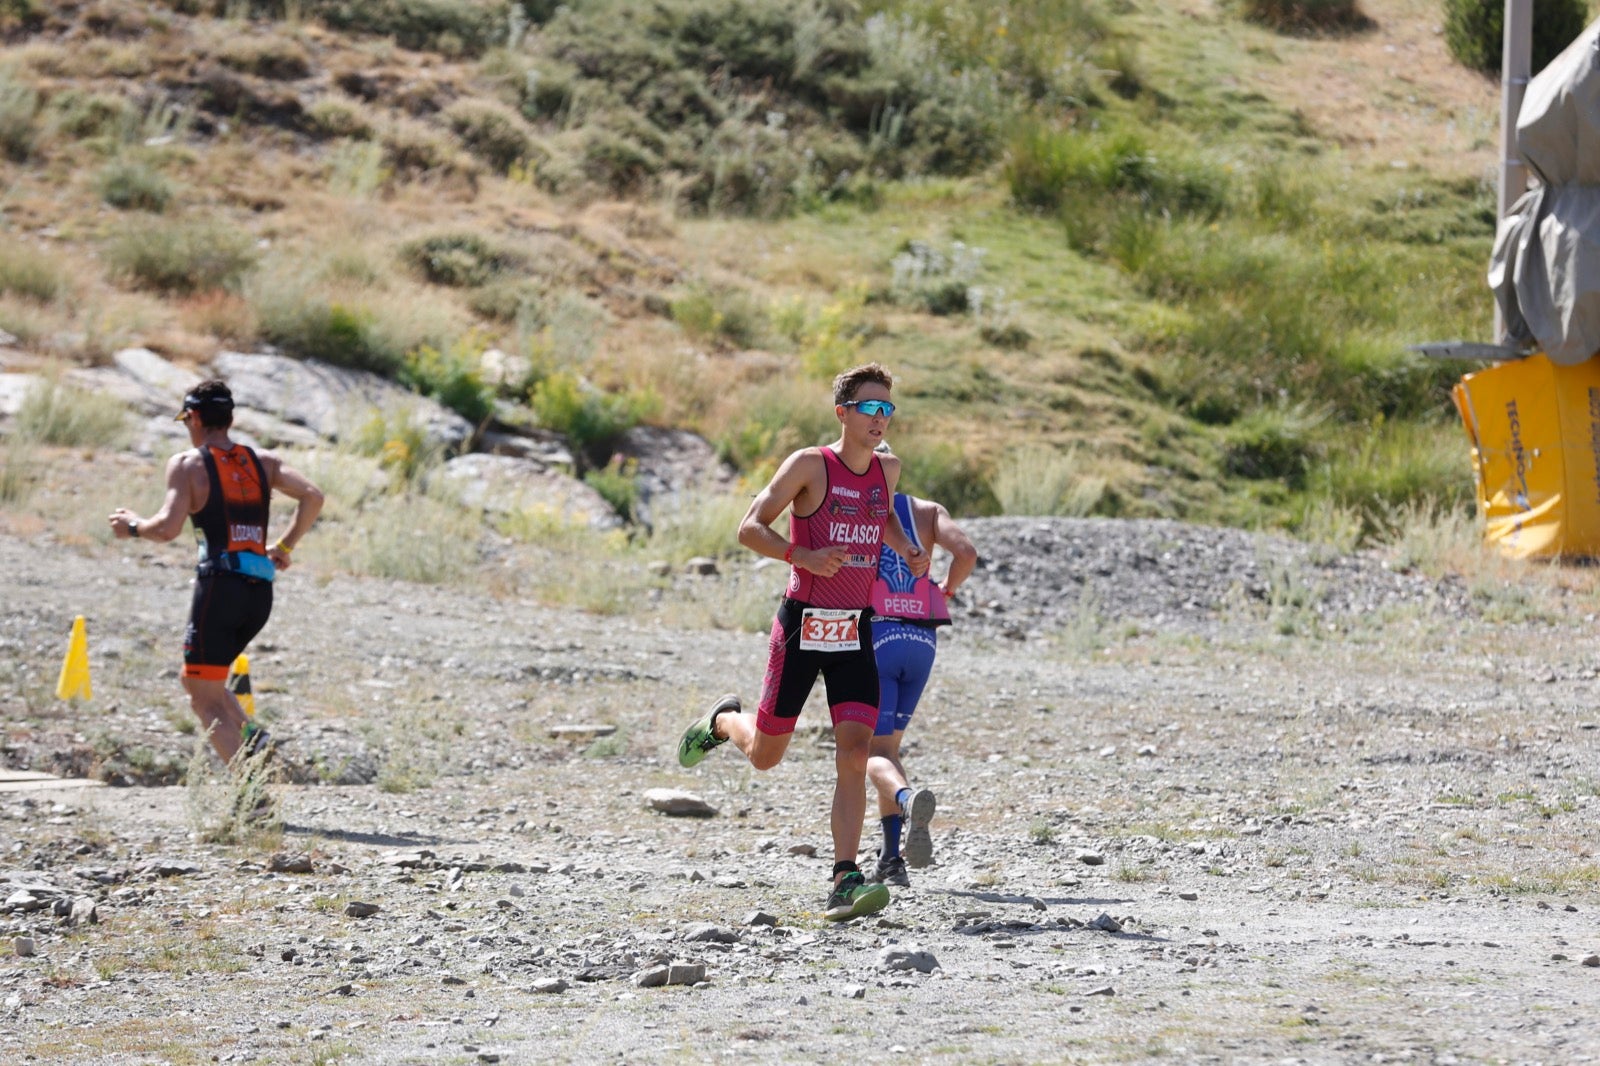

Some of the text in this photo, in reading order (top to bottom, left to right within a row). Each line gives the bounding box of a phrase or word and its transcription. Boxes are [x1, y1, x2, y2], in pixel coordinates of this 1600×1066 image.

[230, 524, 263, 544] LOZANO
[829, 522, 880, 544] VELASCO
[884, 595, 925, 615] PÉREZ
[808, 620, 853, 641] 327
